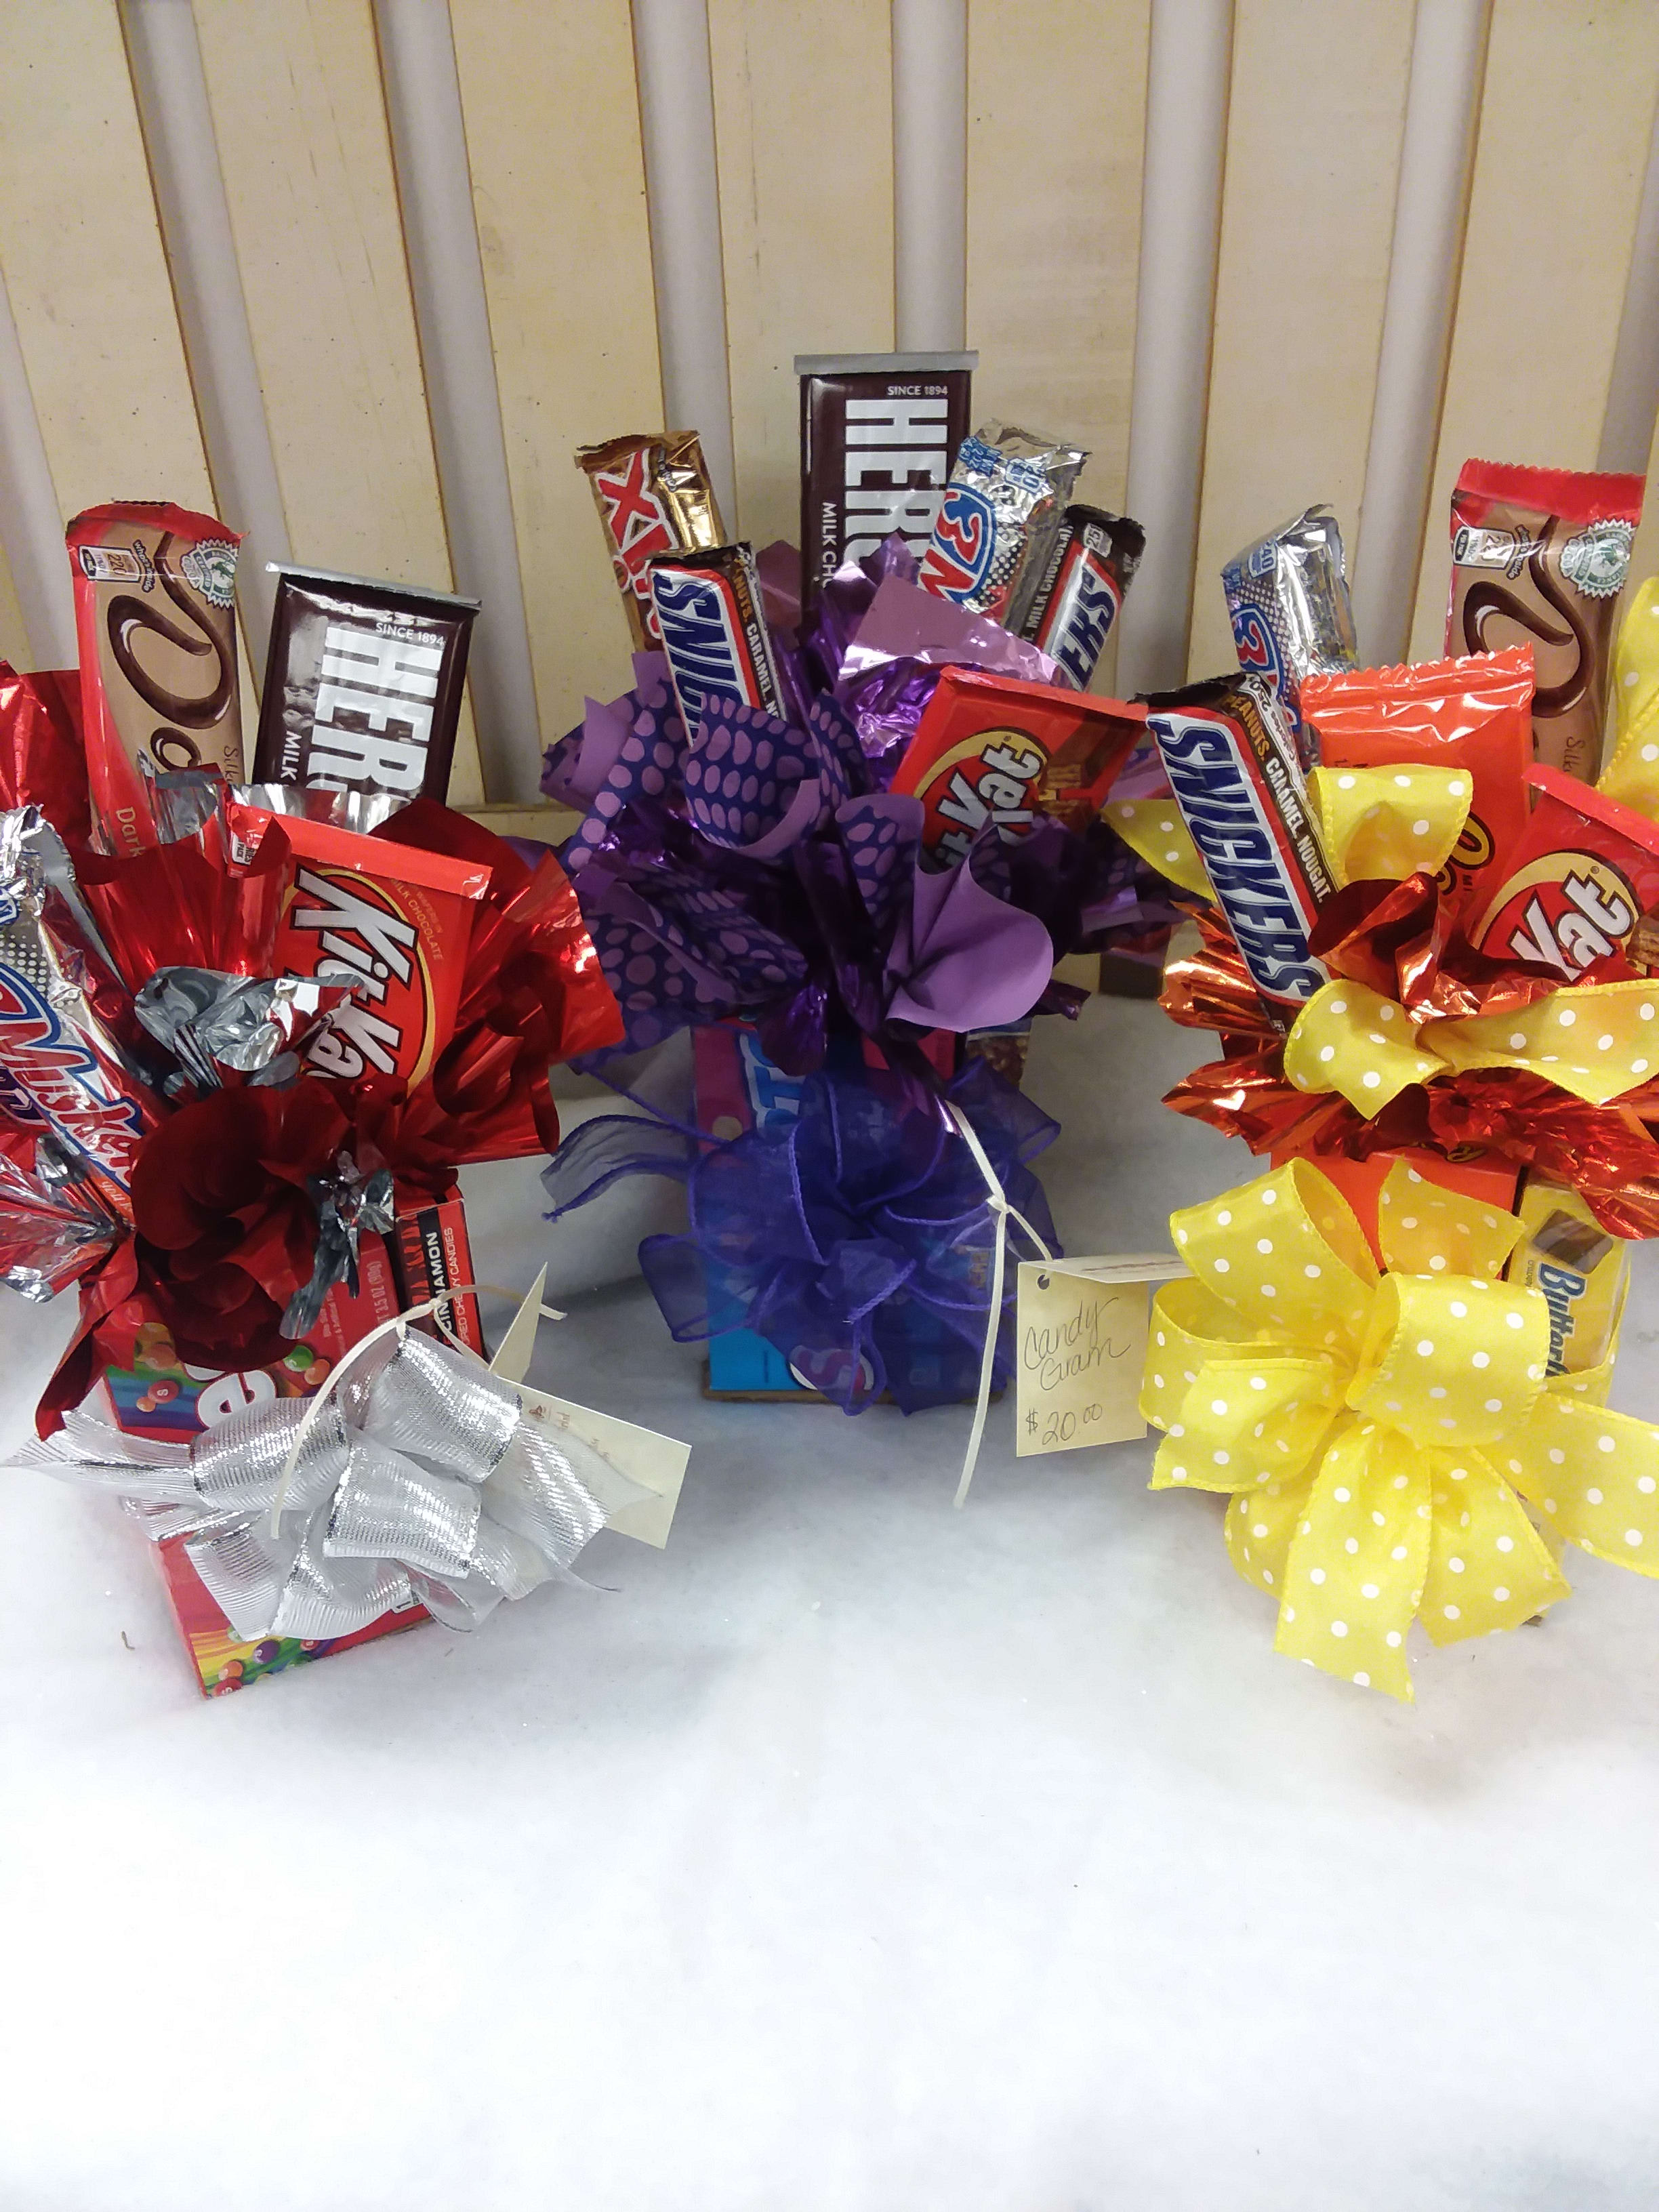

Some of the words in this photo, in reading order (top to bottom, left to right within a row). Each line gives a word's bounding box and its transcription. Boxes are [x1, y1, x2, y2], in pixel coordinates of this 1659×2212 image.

[887, 386, 922, 396] SINCE
[924, 384, 948, 396] 1894
[821, 501, 838, 546] MILK
[375, 622, 414, 640] SINCE
[417, 629, 445, 645] 1894
[306, 627, 446, 792] HER
[280, 730, 302, 781] MILK
[116, 806, 146, 857] Dark
[1148, 718, 1326, 998] SNICKERS
[407, 899, 445, 961] CHOCOLATE
[444, 1227, 460, 1275] CANDIES
[1024, 1296, 1119, 1370] Candy
[1040, 1338, 1132, 1391] Gram
